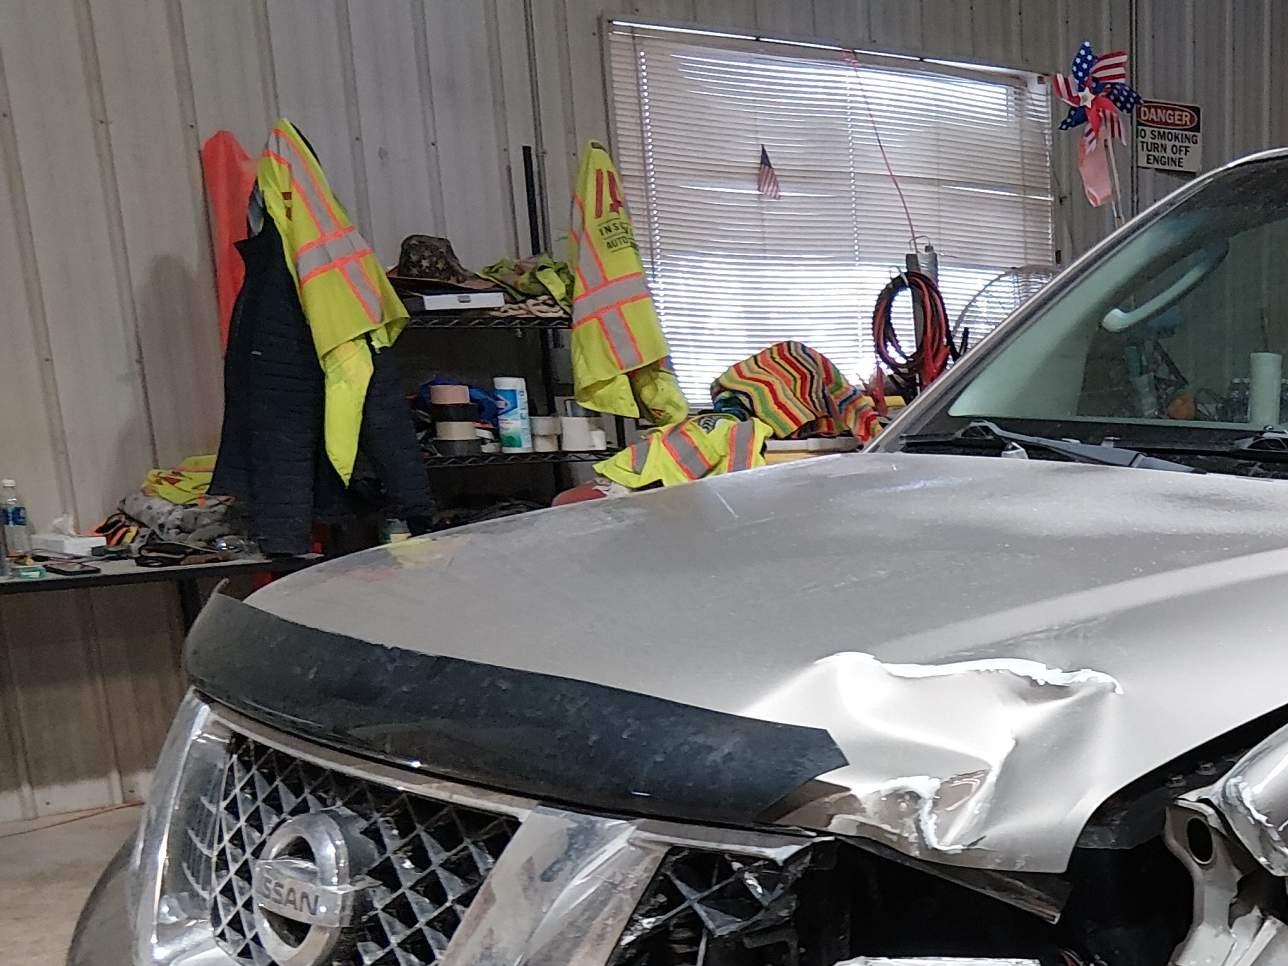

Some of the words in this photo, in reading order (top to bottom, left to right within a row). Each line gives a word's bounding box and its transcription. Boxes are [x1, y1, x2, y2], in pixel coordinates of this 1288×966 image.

[1141, 107, 1191, 125] DANGER
[1150, 130, 1198, 145] SMOKING
[1140, 141, 1167, 154] TURN
[1171, 144, 1191, 156] OFF
[1146, 154, 1184, 168] ENGINE
